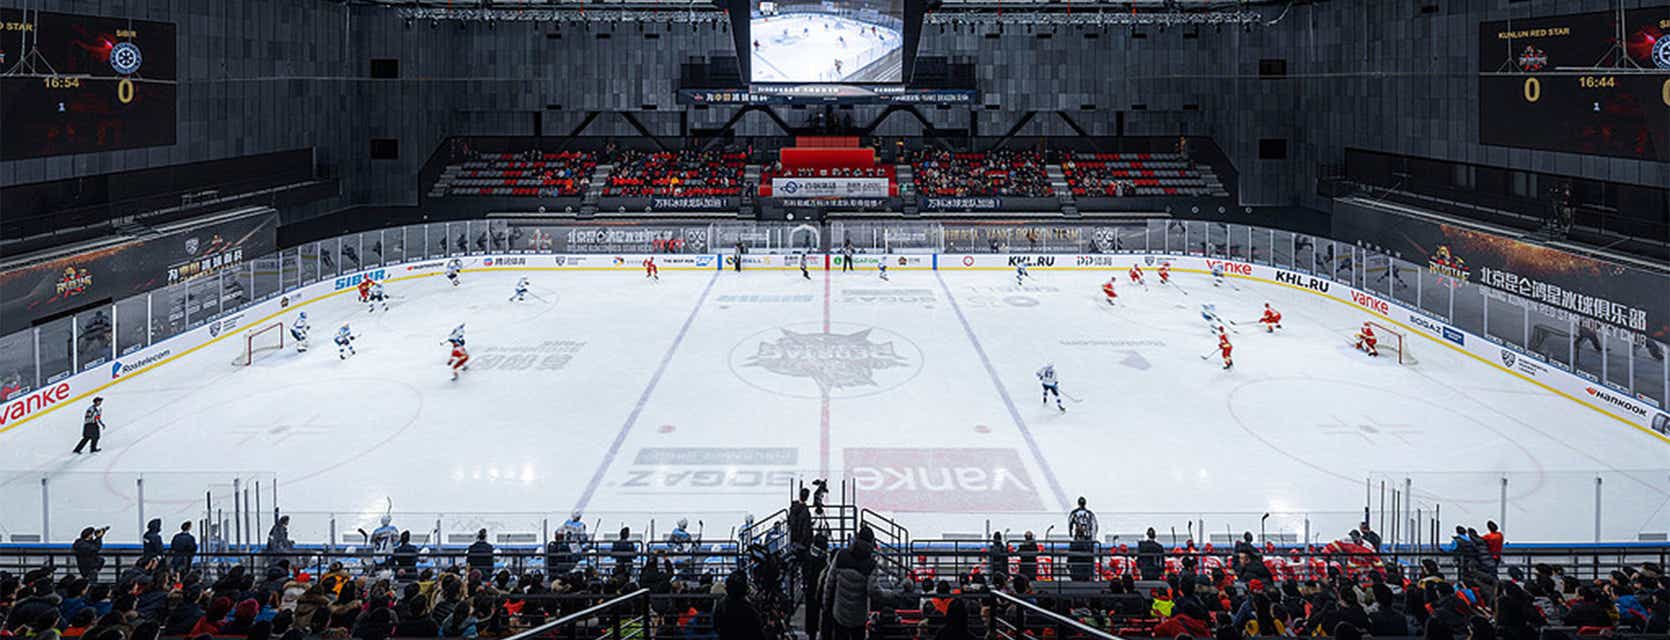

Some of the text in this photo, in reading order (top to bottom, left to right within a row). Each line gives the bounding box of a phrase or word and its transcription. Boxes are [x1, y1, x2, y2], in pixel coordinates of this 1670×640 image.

[6, 22, 33, 31] STAR
[1498, 27, 1570, 39] KUNLUN RED STAR
[43, 78, 80, 88] 16:54
[117, 79, 134, 104] 0
[1524, 77, 1541, 102] 0
[1578, 77, 1616, 88] 16:44
[1206, 259, 1252, 275] vnke
[1275, 270, 1329, 293] KHL.RU
[1350, 289, 1389, 315] vanke
[1480, 266, 1647, 331] 北京昆仑鸿星冰球俱乐部
[0, 383, 70, 425] vanke
